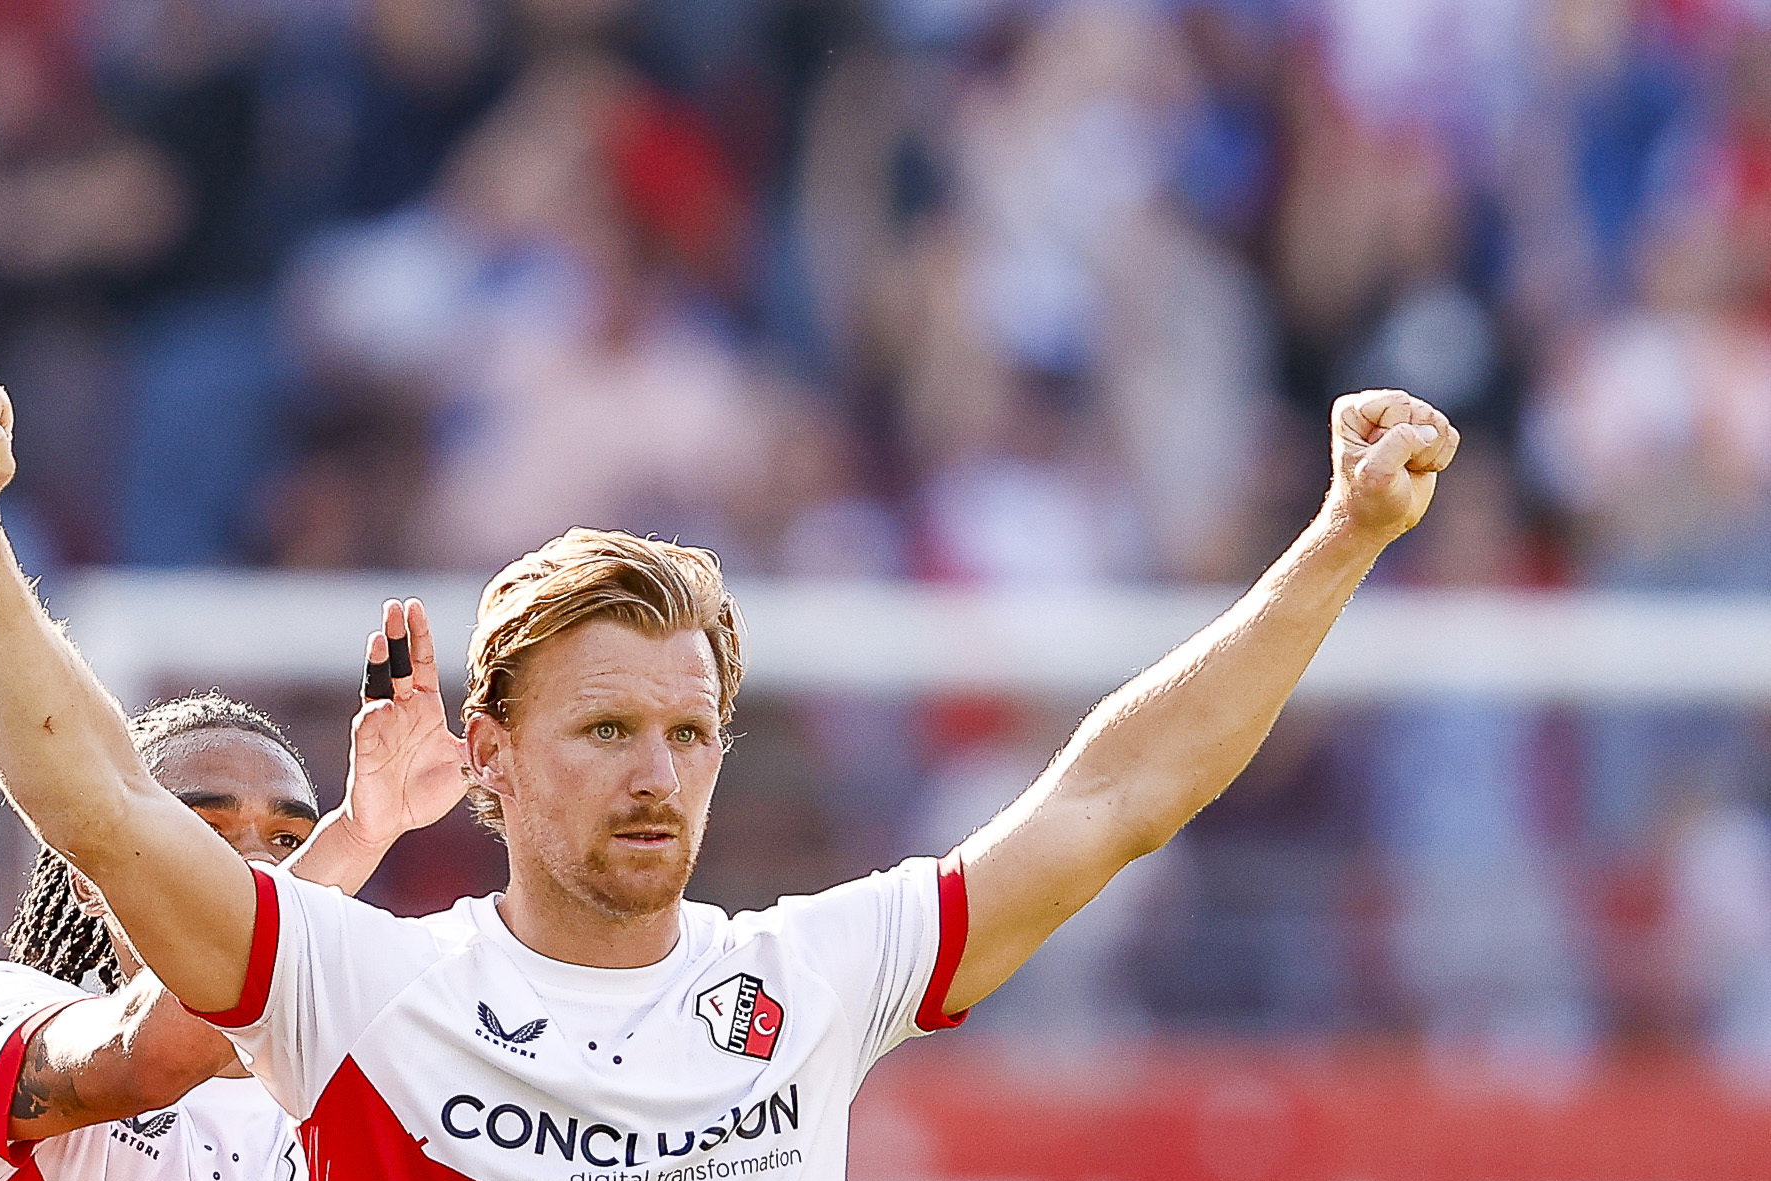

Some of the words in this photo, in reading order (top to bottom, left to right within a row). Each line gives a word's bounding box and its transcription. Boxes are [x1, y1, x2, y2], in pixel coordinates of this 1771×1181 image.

[728, 976, 759, 1054] UTRECHT
[753, 1012, 777, 1036] C
[475, 1028, 537, 1060] CASTORE
[110, 1124, 160, 1160] ASTORE
[440, 1083, 799, 1168] CONCLUSION
